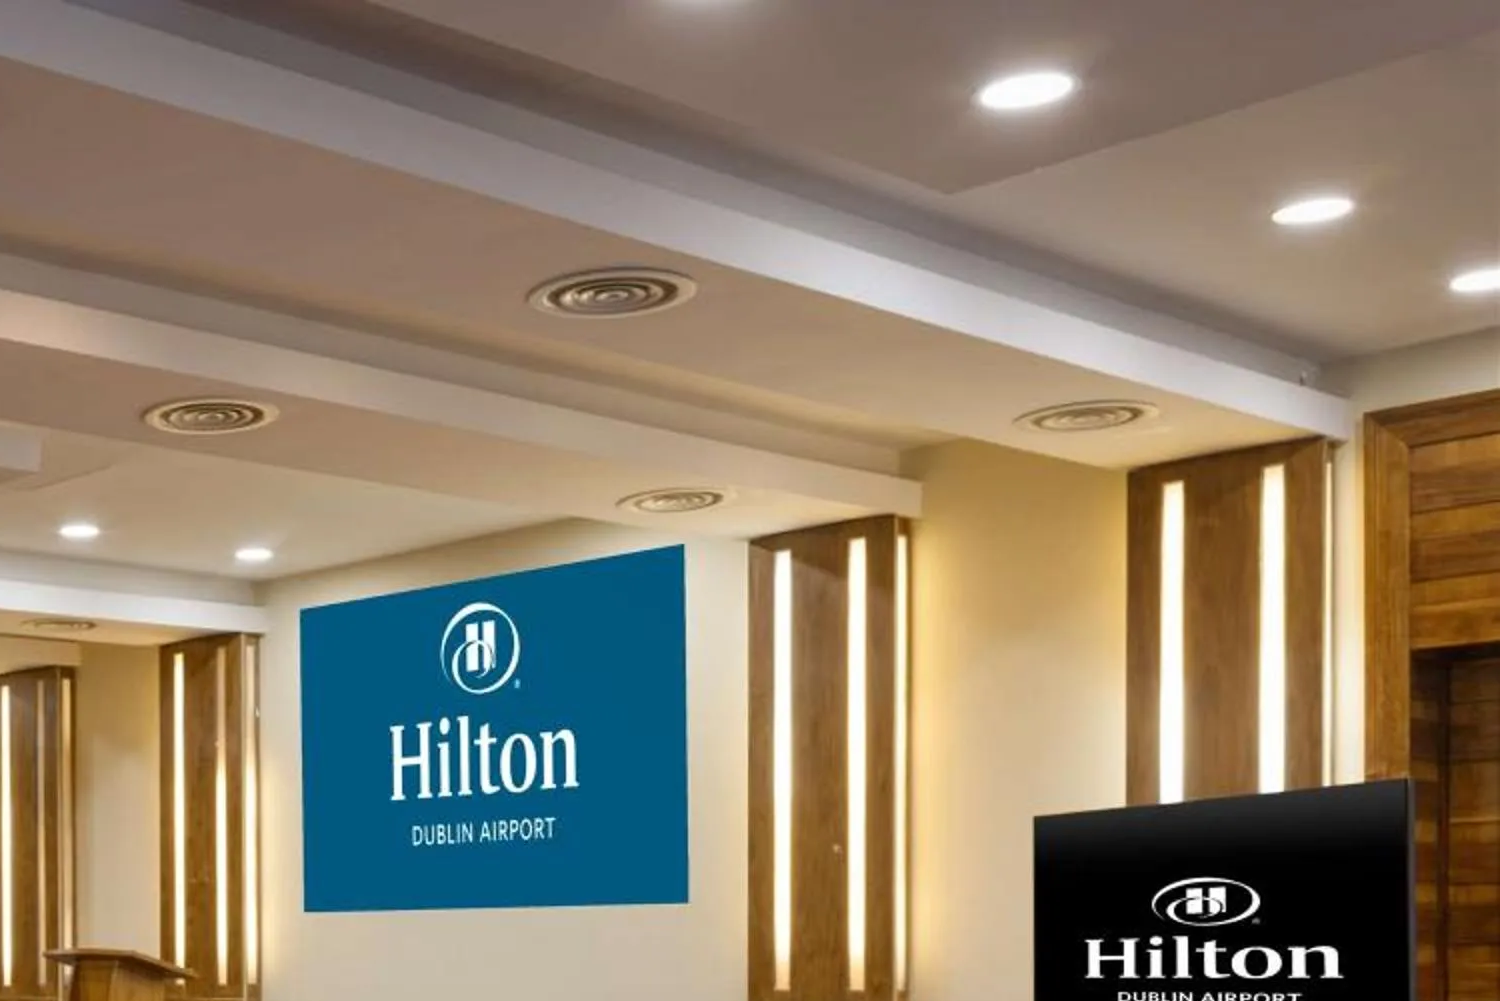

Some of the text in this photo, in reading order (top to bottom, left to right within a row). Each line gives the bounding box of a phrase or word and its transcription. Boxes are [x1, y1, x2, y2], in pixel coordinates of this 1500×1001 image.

[389, 715, 580, 801] Hilton
[412, 817, 556, 847] DUBLIN AIRPORT
[1084, 935, 1344, 979] Hilton
